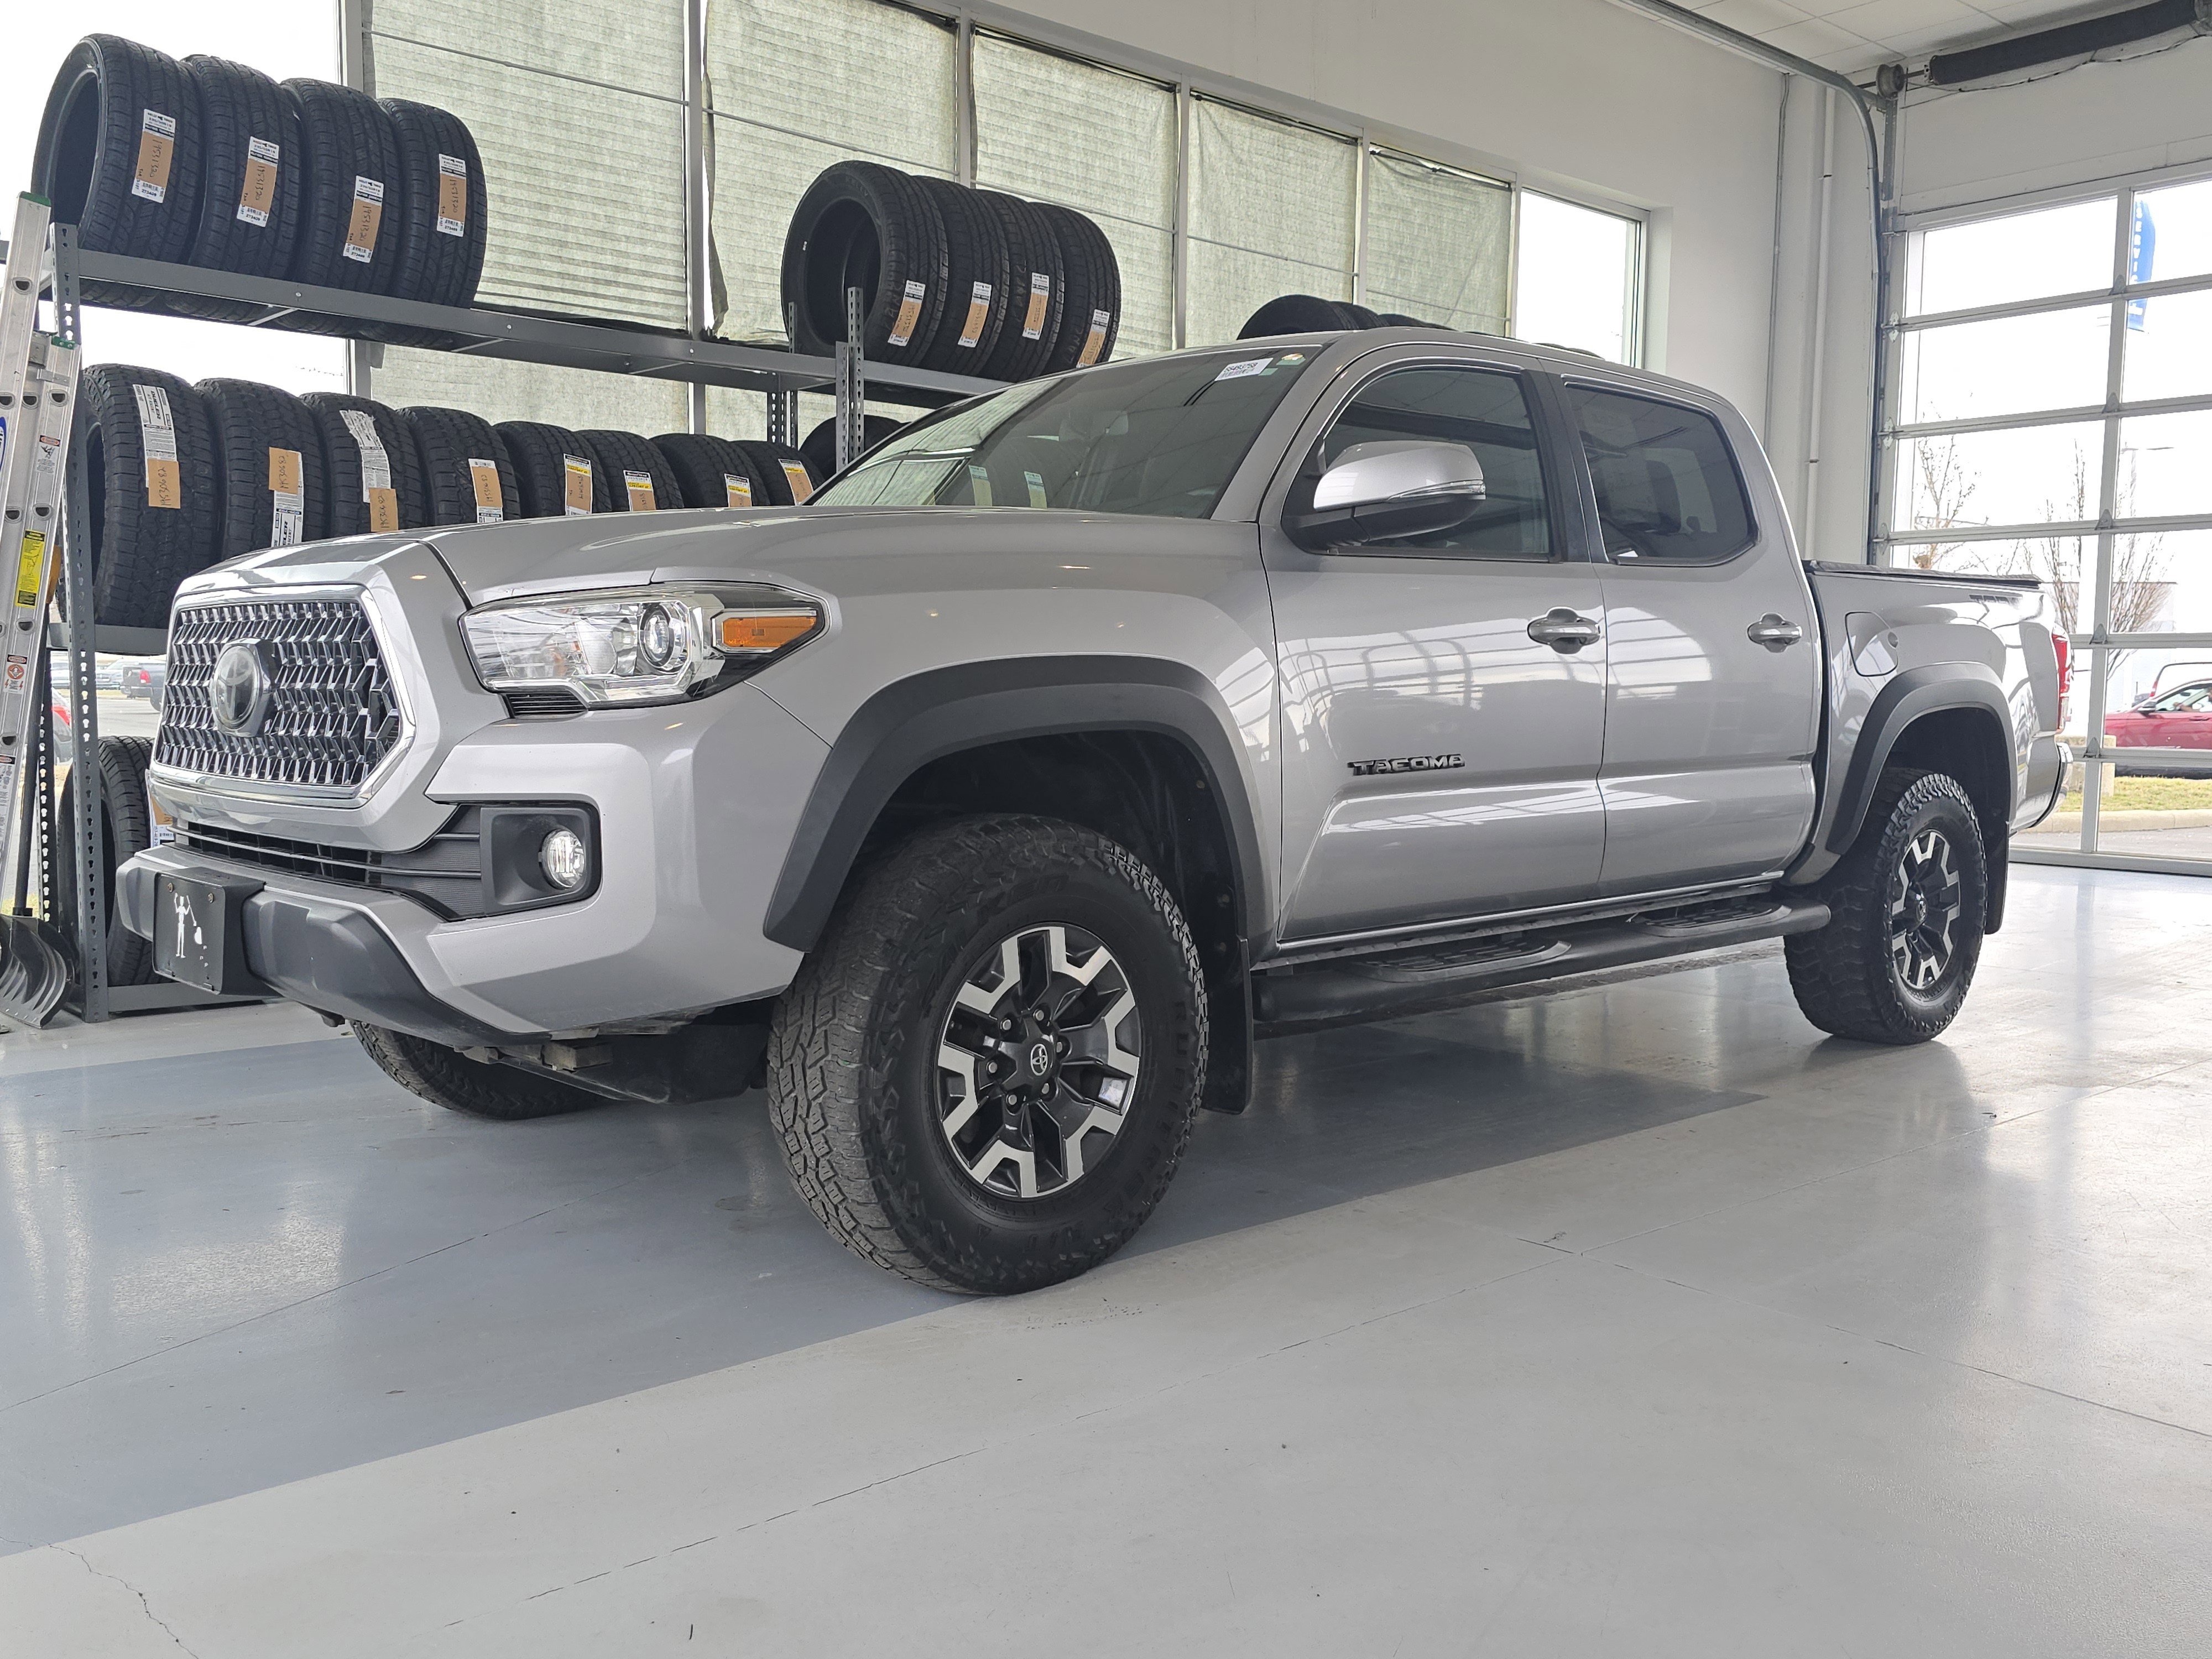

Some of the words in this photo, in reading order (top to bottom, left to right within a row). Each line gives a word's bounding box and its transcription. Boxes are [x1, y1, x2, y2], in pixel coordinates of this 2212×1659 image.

[2130, 206, 2143, 284] SERVIC
[150, 390, 161, 420] DUELER
[1348, 754, 1465, 776] TACOMA
